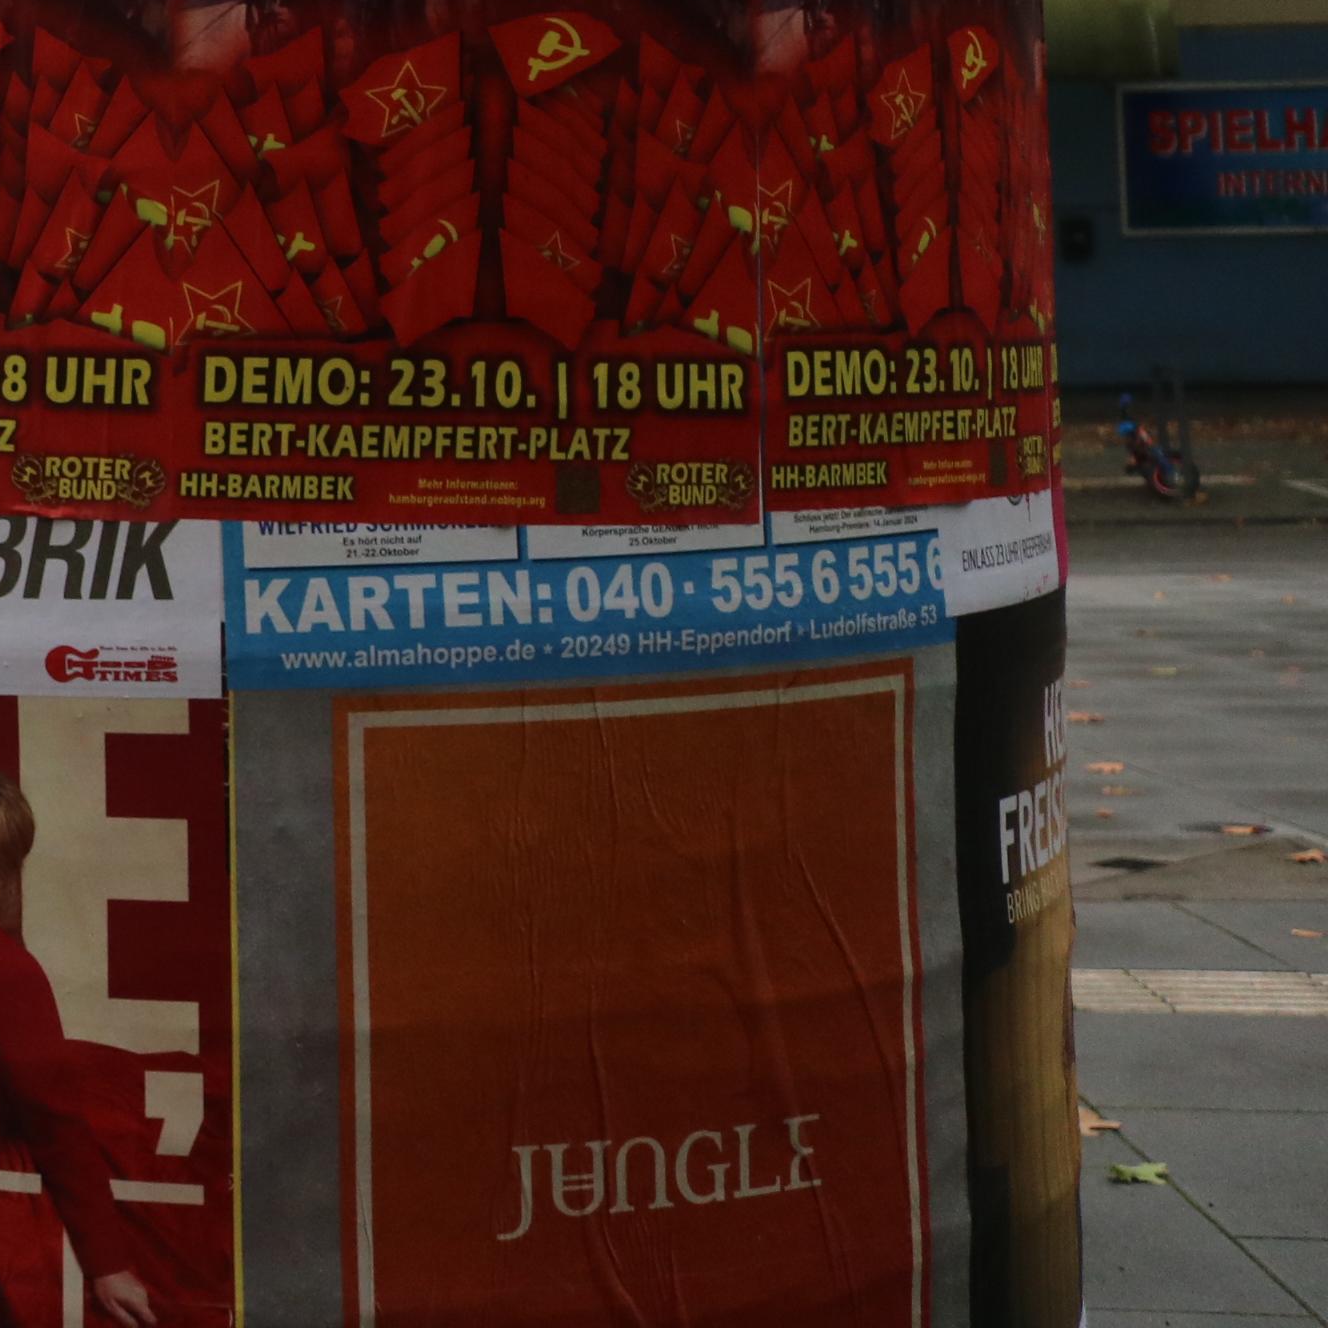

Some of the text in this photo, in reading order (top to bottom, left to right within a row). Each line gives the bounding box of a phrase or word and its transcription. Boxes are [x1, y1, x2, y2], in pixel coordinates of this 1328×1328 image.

[45, 354, 153, 407] UHR
[203, 354, 745, 411] DEMO: 23.10. 18 UHR
[785, 344, 1045, 398] DEMO: 23.10. 18 UHR
[203, 422, 632, 462] BERT-KAEMPFERT-PLATZ
[44, 455, 133, 481] ROTER
[655, 462, 730, 485] ROTER
[771, 460, 889, 489] HH-BARMBEK
[57, 477, 119, 502] BUND
[178, 471, 355, 502] HH-BARMBEK
[416, 477, 443, 491] Mehr
[667, 484, 719, 507] BUND
[380, 534, 406, 546] nicht
[406, 534, 423, 546] auf
[962, 545, 996, 572] EINLASS
[242, 570, 555, 635] KARTEN:
[566, 563, 669, 621] 040
[711, 552, 803, 611] 555
[811, 549, 841, 604] 6
[847, 540, 921, 601] 555
[281, 604, 939, 670] www.almahoppe.de 20249 HH-Eppendorf Ludolfstraße 53
[95, 670, 179, 683] TIMES
